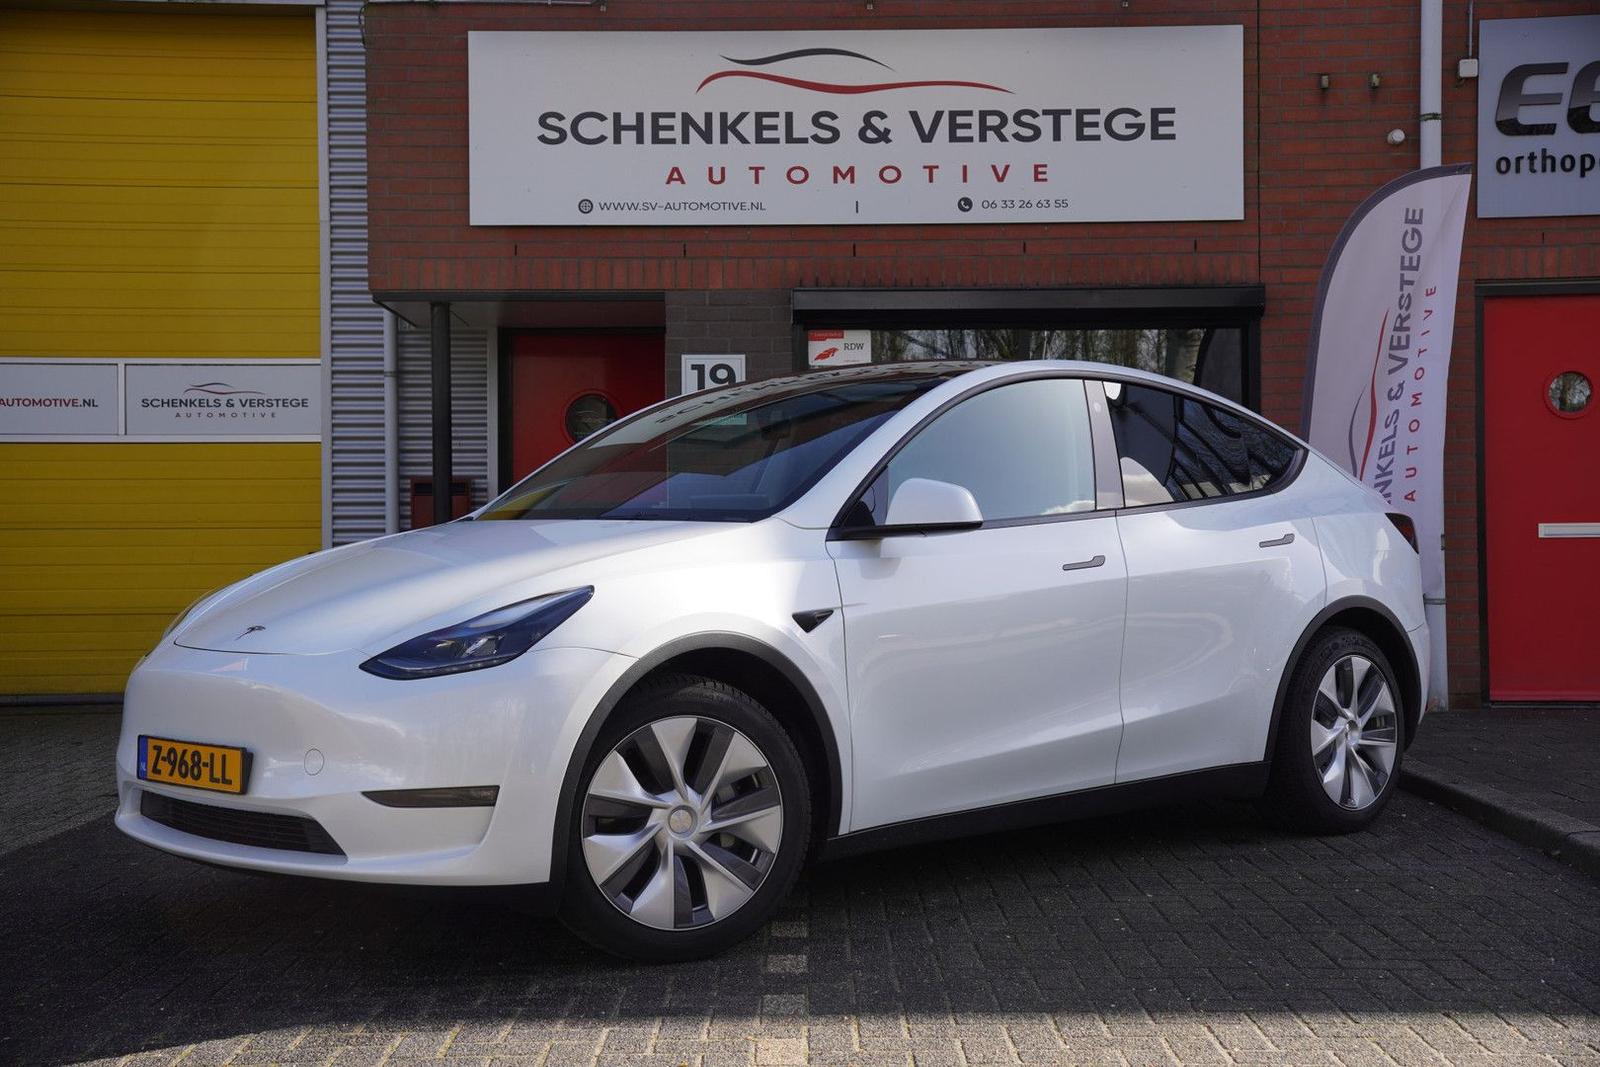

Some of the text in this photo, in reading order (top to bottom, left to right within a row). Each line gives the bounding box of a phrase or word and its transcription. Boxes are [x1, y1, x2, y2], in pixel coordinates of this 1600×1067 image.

[537, 107, 1178, 146] SCHENKELS & VERSTEGE
[664, 163, 1050, 186] AUTOMOTIVE
[1495, 147, 1600, 179] orthop
[598, 201, 767, 212] WWW.SV-AUTOMOTIVE.NL
[981, 199, 1070, 210] 06 33 26 63 55
[1387, 207, 1425, 376] VERSTEGE
[843, 342, 865, 351] RDW
[690, 363, 737, 391] 19
[1387, 380, 1406, 402] &
[1403, 284, 1438, 502] AUTOMOTIVE
[141, 397, 309, 409] SCHENKELS & VERSTEGE
[174, 411, 277, 419] AUTOMOTIVE
[151, 744, 233, 786] Z-968-LL
